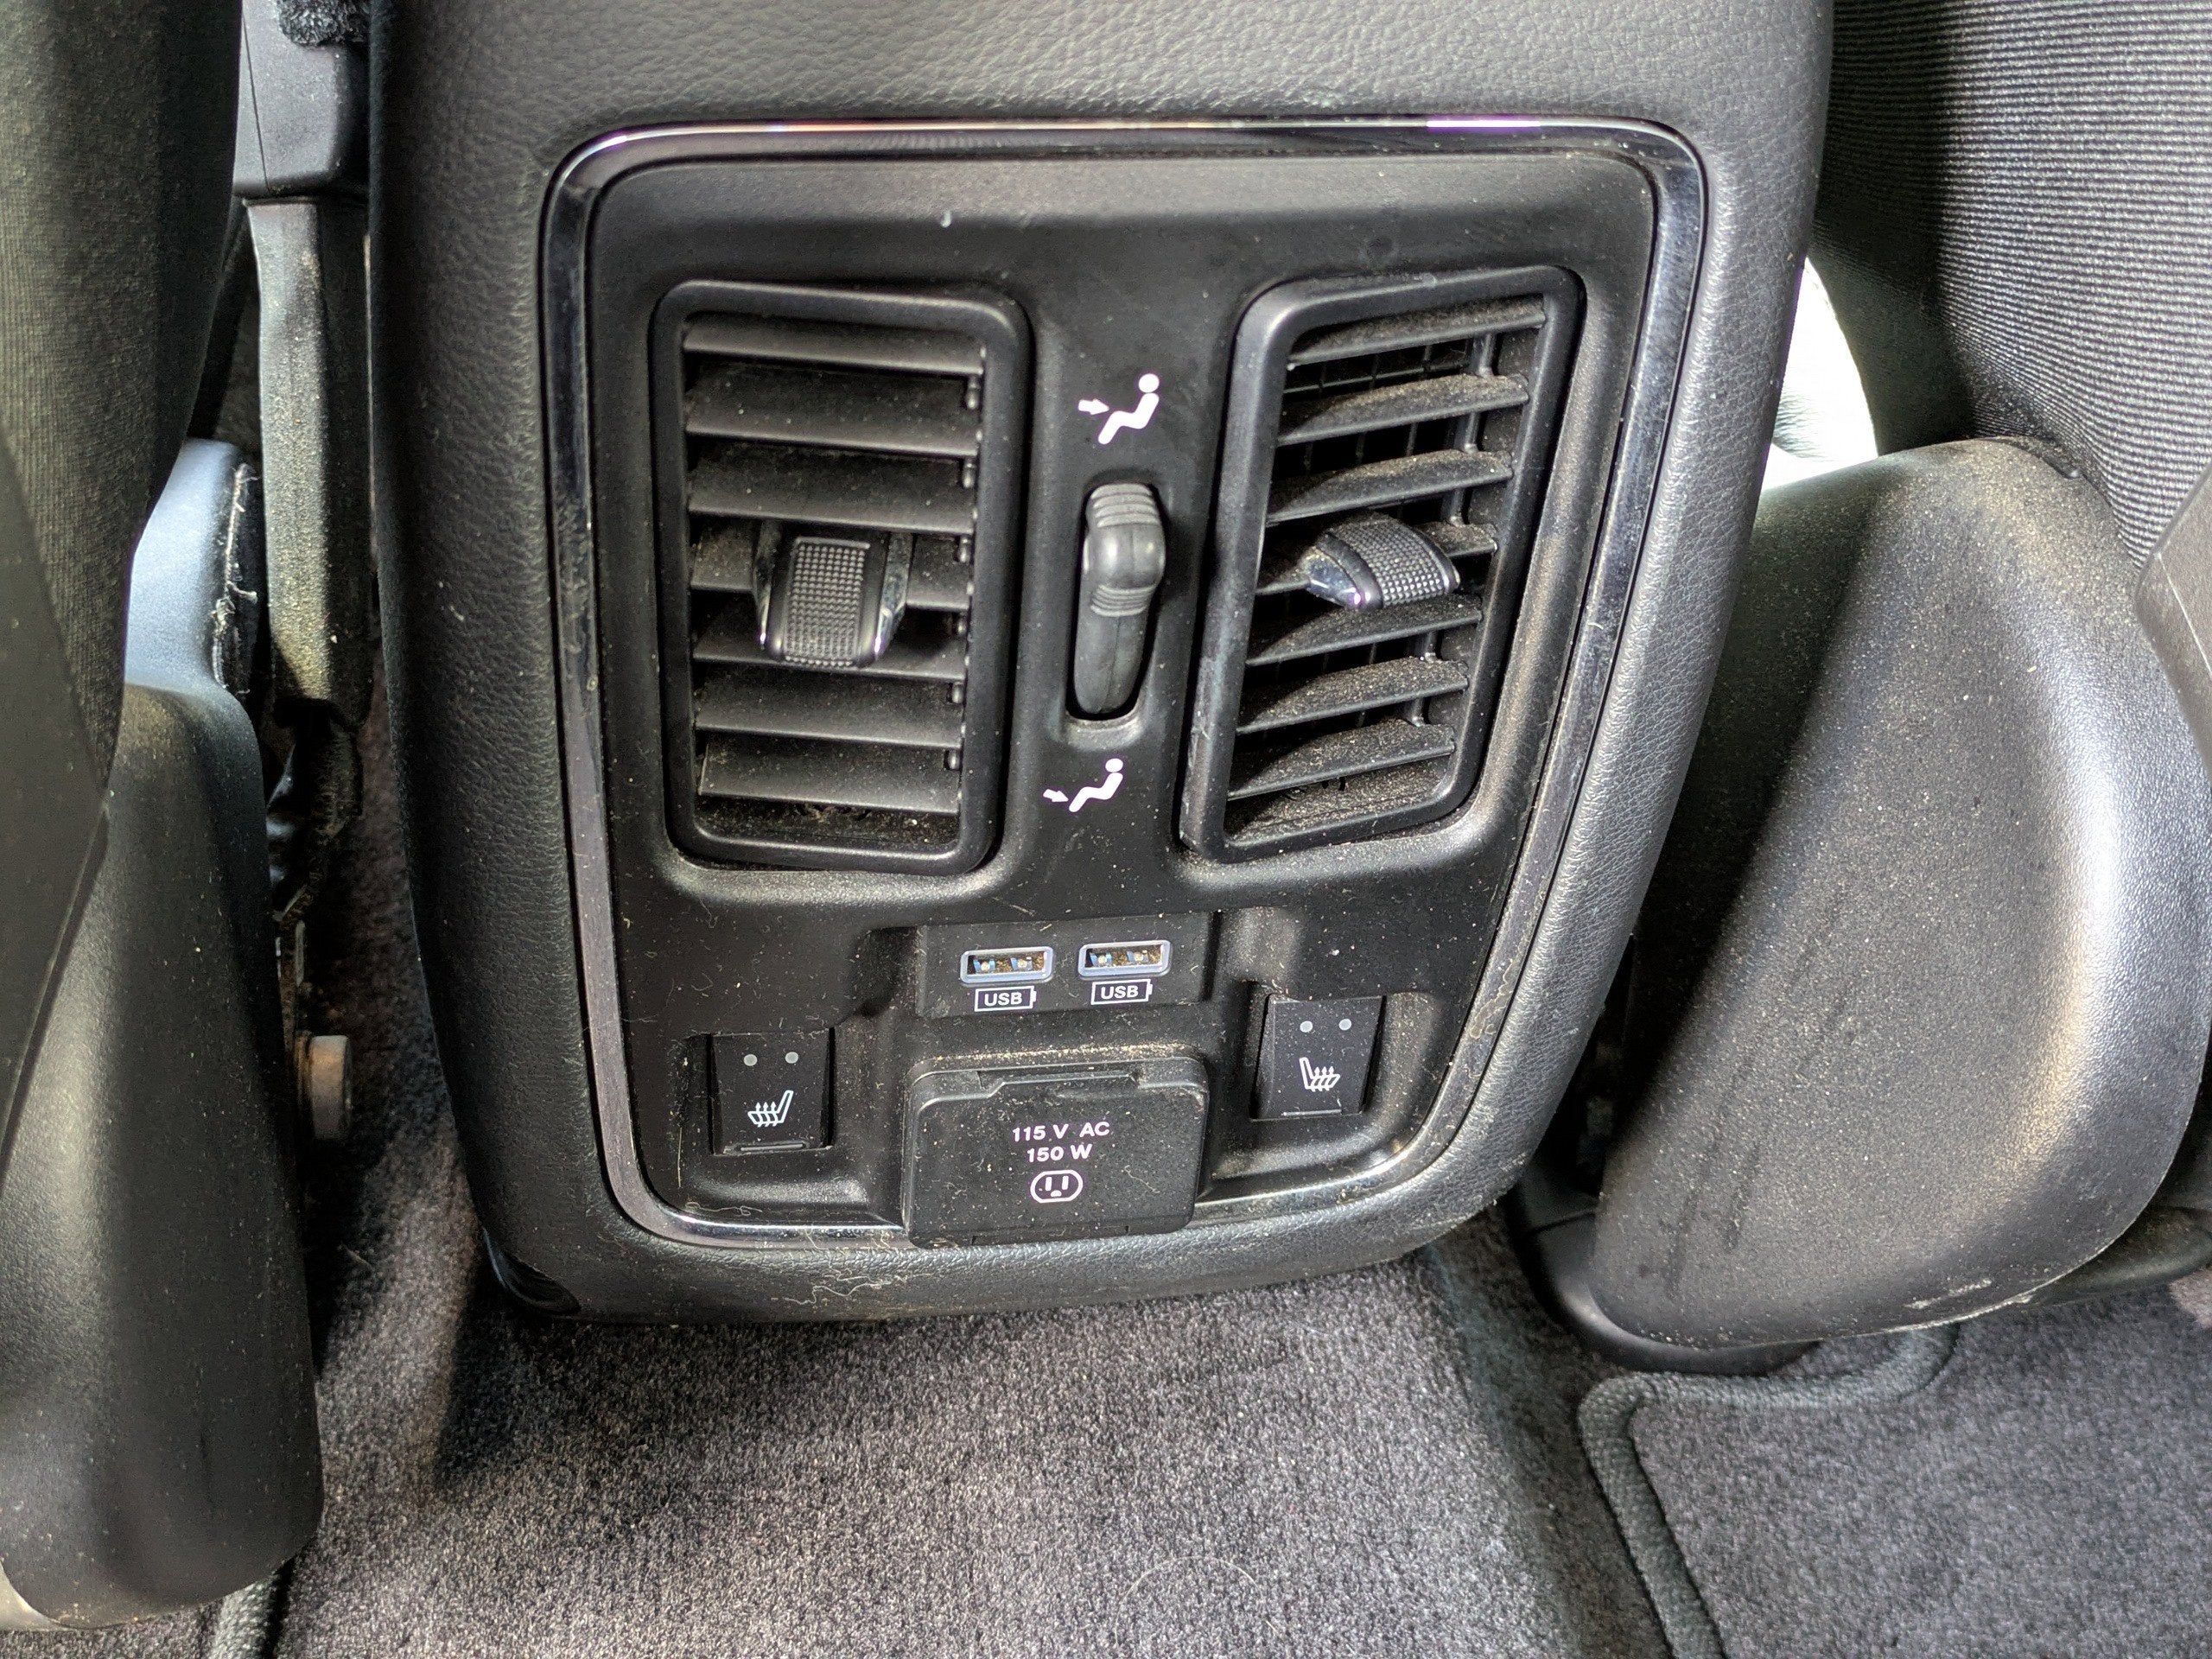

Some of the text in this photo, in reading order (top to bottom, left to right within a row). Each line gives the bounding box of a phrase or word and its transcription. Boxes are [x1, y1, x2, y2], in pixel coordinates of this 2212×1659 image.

[983, 992, 1023, 1007] USB
[1101, 985, 1139, 1000] USB
[1012, 1121, 1110, 1142] 115 V AC
[1027, 1143, 1093, 1163] 150 W
